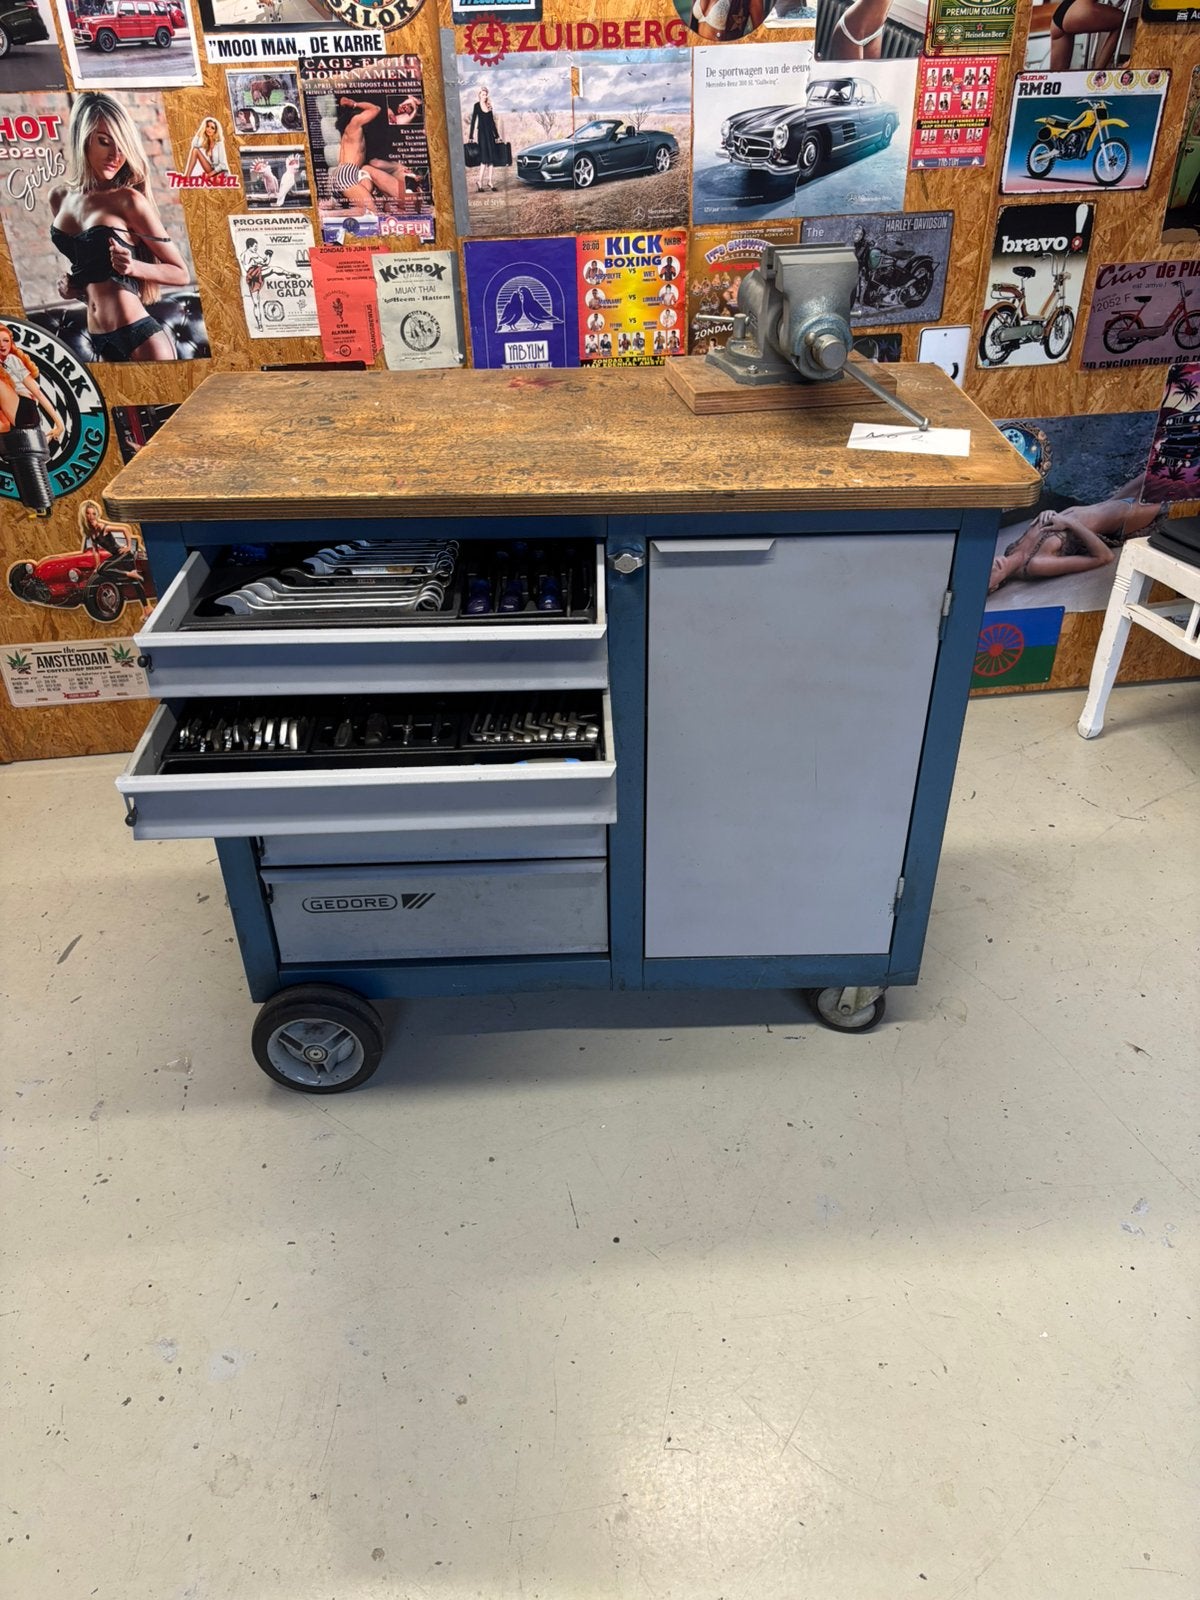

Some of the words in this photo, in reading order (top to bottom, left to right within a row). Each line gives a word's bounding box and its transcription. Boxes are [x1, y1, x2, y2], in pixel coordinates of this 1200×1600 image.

[946, 7, 980, 16] PREMIUM
[981, 6, 1011, 16] QUALITY
[515, 19, 688, 51] ZUIDBERG
[310, 37, 329, 53] DE
[334, 34, 382, 52] KARRE
[305, 69, 418, 81] TOURNAMENT
[705, 67, 717, 78] De
[718, 66, 763, 79] sportwagen
[765, 65, 779, 74] van
[781, 63, 790, 73] de
[349, 81, 396, 89] ZUIDOOST-HAL
[0, 115, 61, 141] HOT
[0, 147, 45, 159] 2020
[7, 147, 67, 214] Girls
[233, 217, 309, 226] PROGRAMMA
[885, 217, 948, 232] HARLEY-DAVIDSON
[806, 228, 825, 237] The
[319, 246, 345, 254] ZONDAG
[605, 234, 664, 256] KICK
[604, 255, 662, 269] BOXING
[379, 262, 447, 284] KICKBOX
[1095, 263, 1156, 290] Ciao
[1155, 262, 1176, 279] de
[266, 280, 314, 290] KICKBOX
[395, 286, 416, 295] MUAY
[419, 285, 436, 293] THAI
[276, 289, 307, 298] GALA
[1124, 292, 1132, 303] F
[694, 322, 734, 341] ZONDAG
[527, 343, 545, 361] YUM
[1177, 354, 1190, 363] de
[6, 323, 92, 399] SPARK
[53, 426, 104, 492] BANG
[63, 646, 76, 654] the
[36, 652, 110, 669] AMSTERDAM
[310, 897, 390, 910] GEDORE
